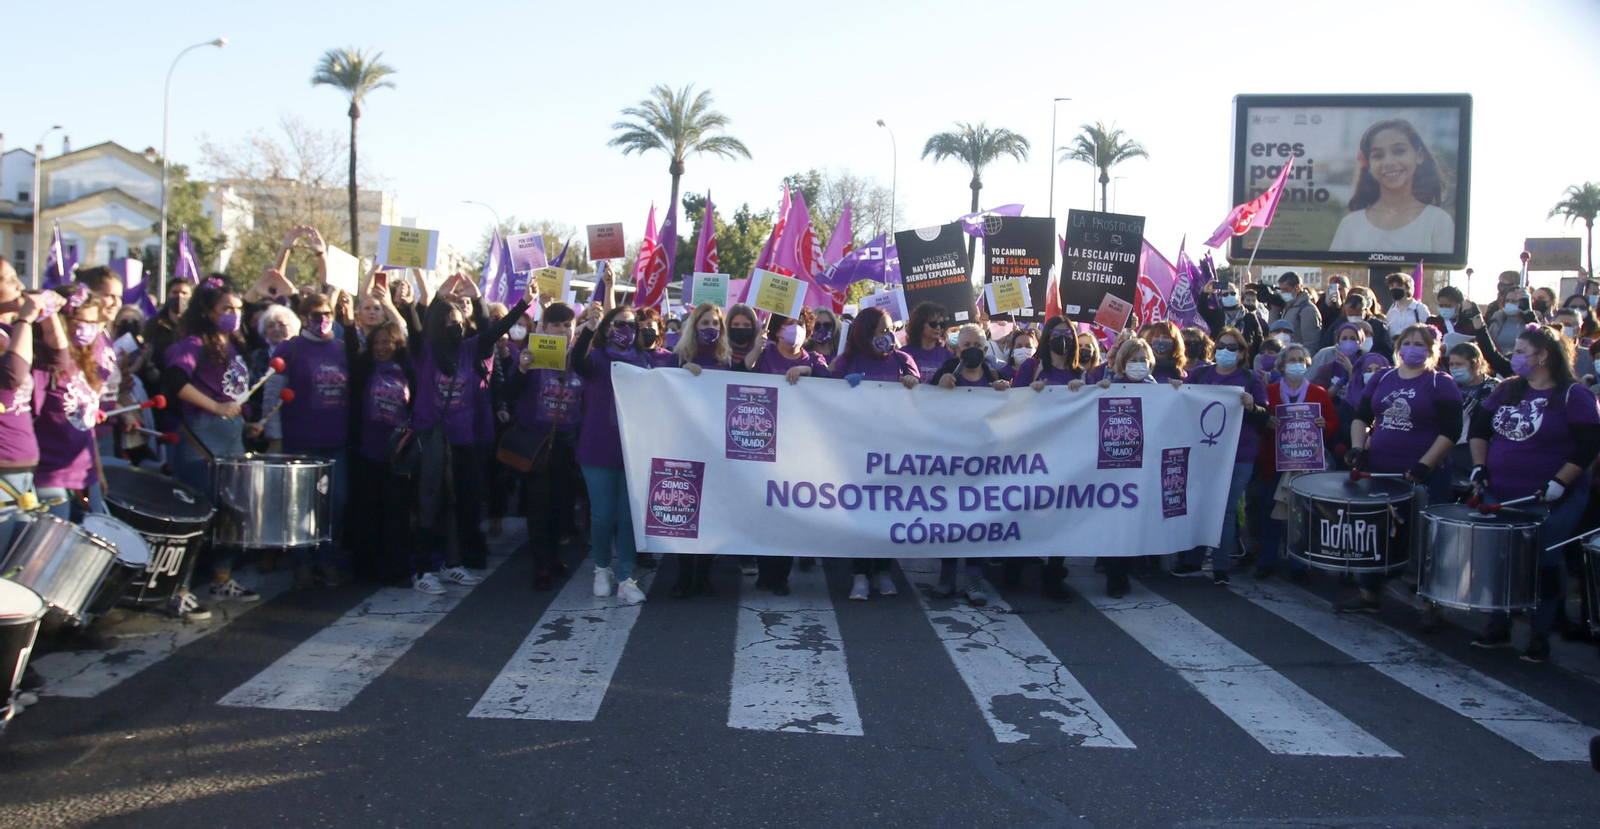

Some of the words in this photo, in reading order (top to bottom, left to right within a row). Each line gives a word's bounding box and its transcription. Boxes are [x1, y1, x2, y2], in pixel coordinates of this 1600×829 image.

[1250, 142, 1305, 158] eres
[992, 248, 999, 256] YO
[1001, 248, 1026, 256] CAMINO
[1068, 247, 1079, 257] LA
[1082, 248, 1136, 263] ESCLAVITUD
[922, 252, 959, 264] MUJERES
[1368, 253, 1405, 262] JCDecaux
[912, 264, 924, 273] HAY
[925, 260, 956, 272] PERSONAS
[1010, 266, 1028, 274] AÑOS
[1087, 261, 1114, 272] SIGUE
[906, 273, 927, 282] SIENDO
[929, 267, 966, 279] EXPLOTADAS
[1072, 271, 1126, 285] EXISTIENDO.
[916, 280, 942, 289] NUESTRA
[944, 275, 968, 284] CIUDAD.
[738, 406, 765, 415] SOMOS
[1109, 417, 1132, 425] SOMOS
[1286, 421, 1311, 430] SOMOS
[742, 438, 765, 448] MUNDO
[1112, 447, 1133, 457] MUNDO
[1290, 449, 1312, 458] MUNDO
[866, 452, 1048, 476] PLATAFORMA
[662, 480, 689, 490] SOMOS
[766, 480, 948, 511] NOSOTRAS
[958, 482, 1138, 511] DECIDIMOS
[663, 514, 687, 524] MUNDO
[889, 517, 1021, 544] CÓRDOBA
